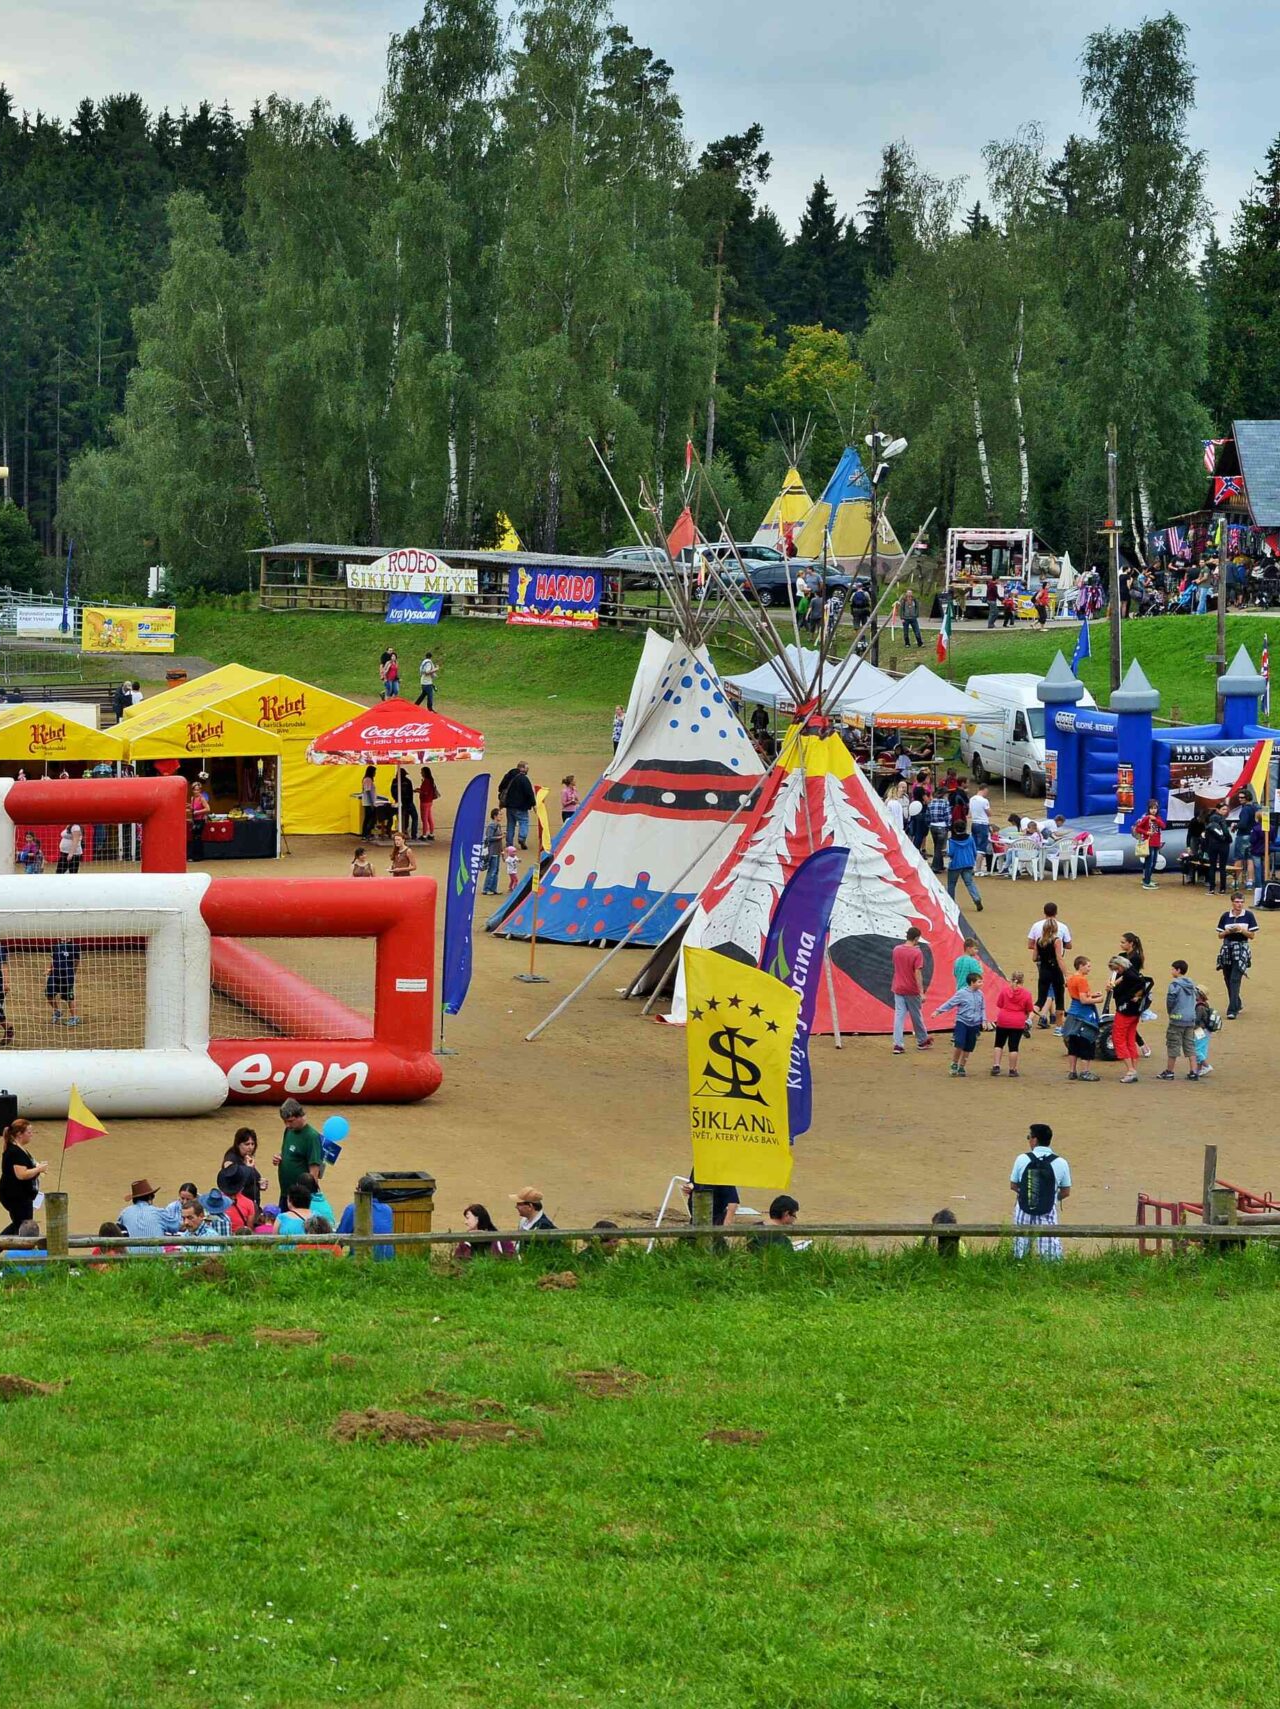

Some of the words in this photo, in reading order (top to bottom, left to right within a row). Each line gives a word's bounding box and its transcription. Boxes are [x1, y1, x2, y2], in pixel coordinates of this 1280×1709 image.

[388, 550, 437, 573] RODEO
[535, 573, 595, 603] HARIBO
[258, 693, 306, 724] Rebel
[186, 720, 224, 744] Rebel
[360, 722, 434, 739] Coca-Cola
[877, 717, 908, 726] Registrace
[29, 724, 66, 745] Rebel
[692, 1106, 775, 1134] ŠIKLAND
